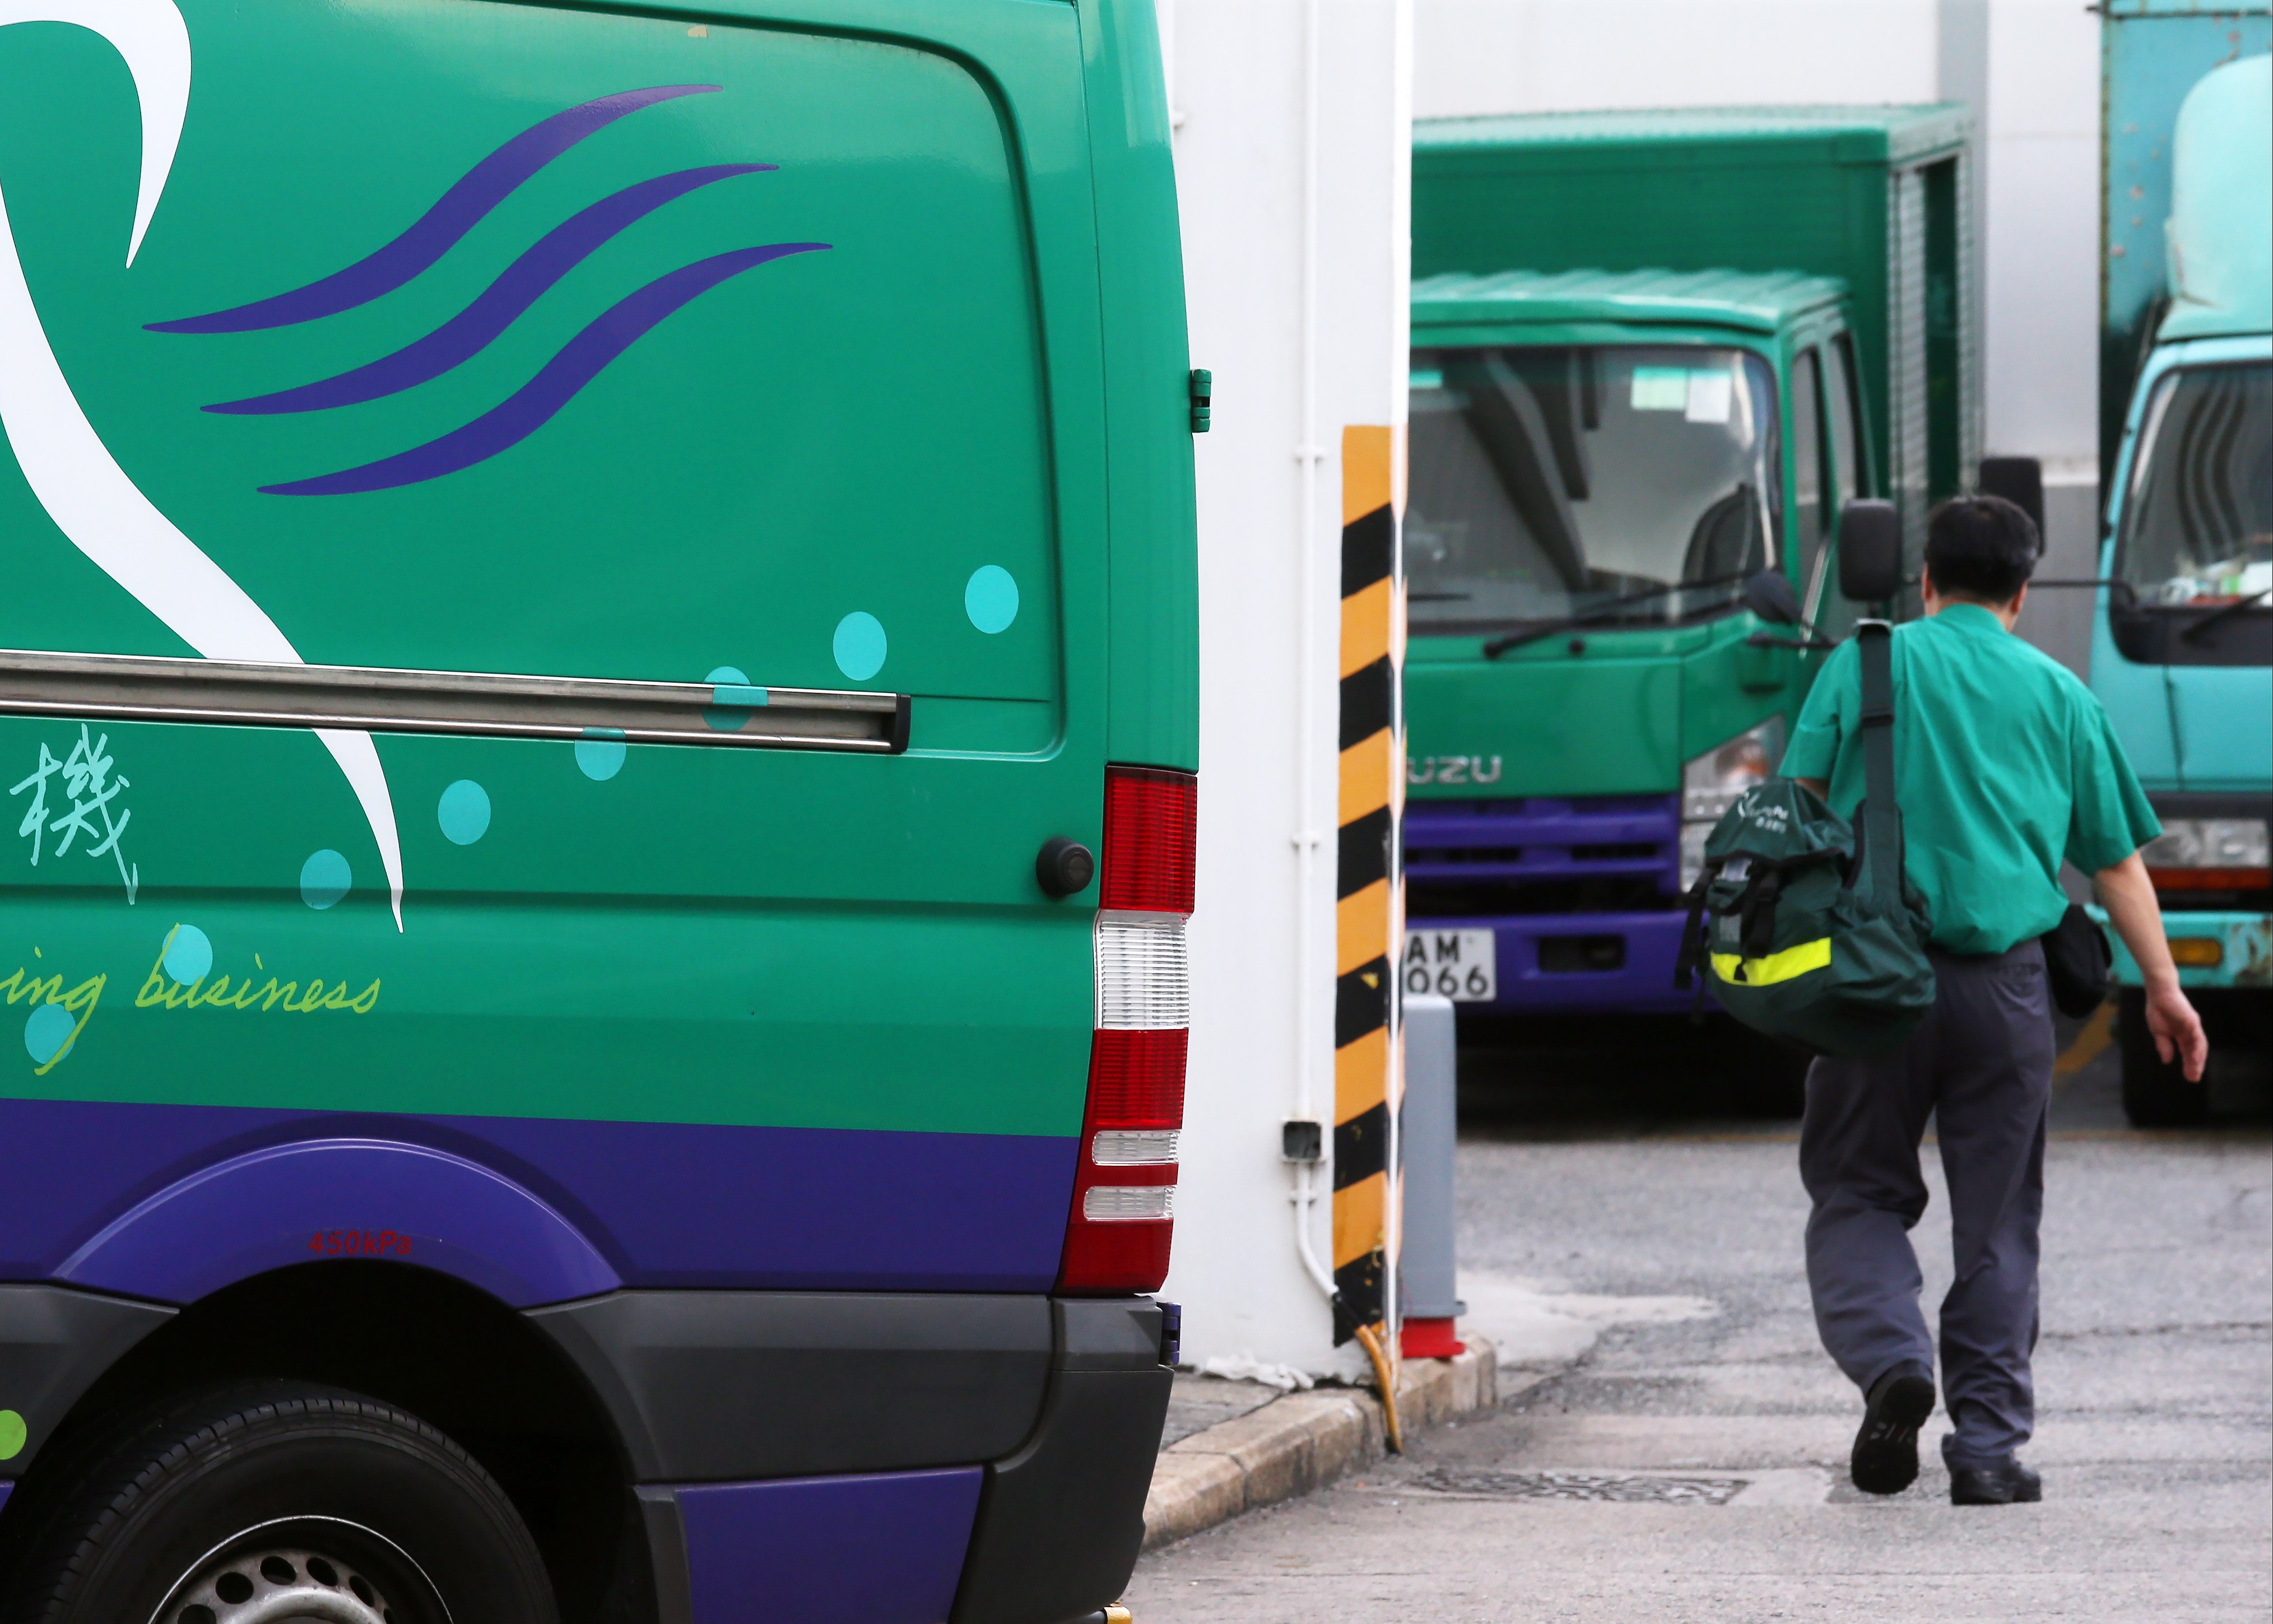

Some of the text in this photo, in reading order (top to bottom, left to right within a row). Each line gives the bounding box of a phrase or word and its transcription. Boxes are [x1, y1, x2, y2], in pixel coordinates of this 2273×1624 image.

[10, 723, 138, 905] 機
[1407, 934, 1459, 964] AM
[135, 923, 380, 1013] business
[1407, 965, 1488, 997] 066
[309, 1230, 412, 1255] 450kPa
